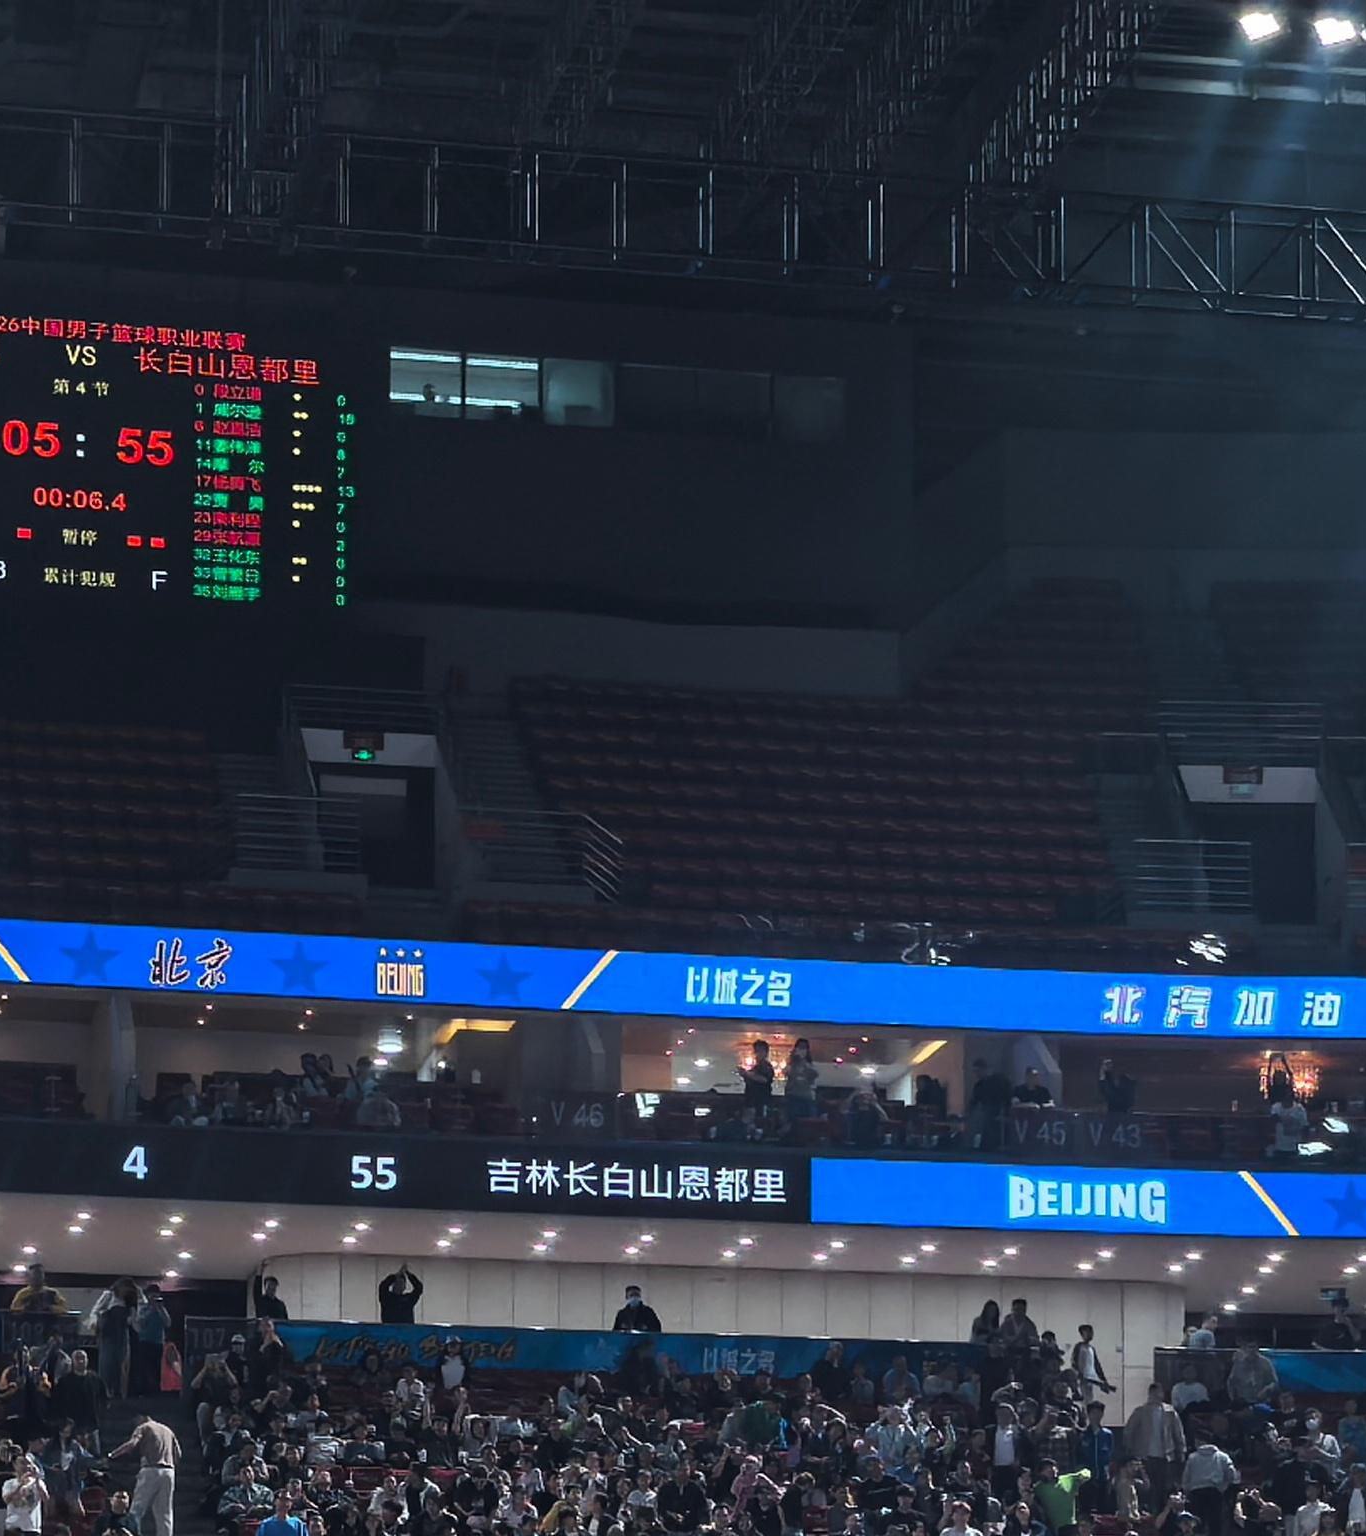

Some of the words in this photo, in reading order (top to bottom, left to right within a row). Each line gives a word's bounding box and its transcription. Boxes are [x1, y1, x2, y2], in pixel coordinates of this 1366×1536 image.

[66, 345, 96, 366] VS
[134, 348, 320, 386] 长白山恩都里
[116, 427, 174, 467] 55
[33, 486, 127, 512] 00:06.4
[151, 571, 168, 591] F
[148, 939, 233, 992] 北京
[376, 961, 425, 998] BEIJING
[686, 966, 792, 1008] 以城之名
[1102, 983, 1343, 1028] 北汽加油
[572, 1103, 605, 1129] 46
[1037, 1120, 1066, 1147] 45
[122, 1147, 148, 1180] 4
[351, 1155, 397, 1190] 55
[487, 1158, 787, 1204] 吉林长白山恩都里
[1008, 1174, 1167, 1224] BEIJING
